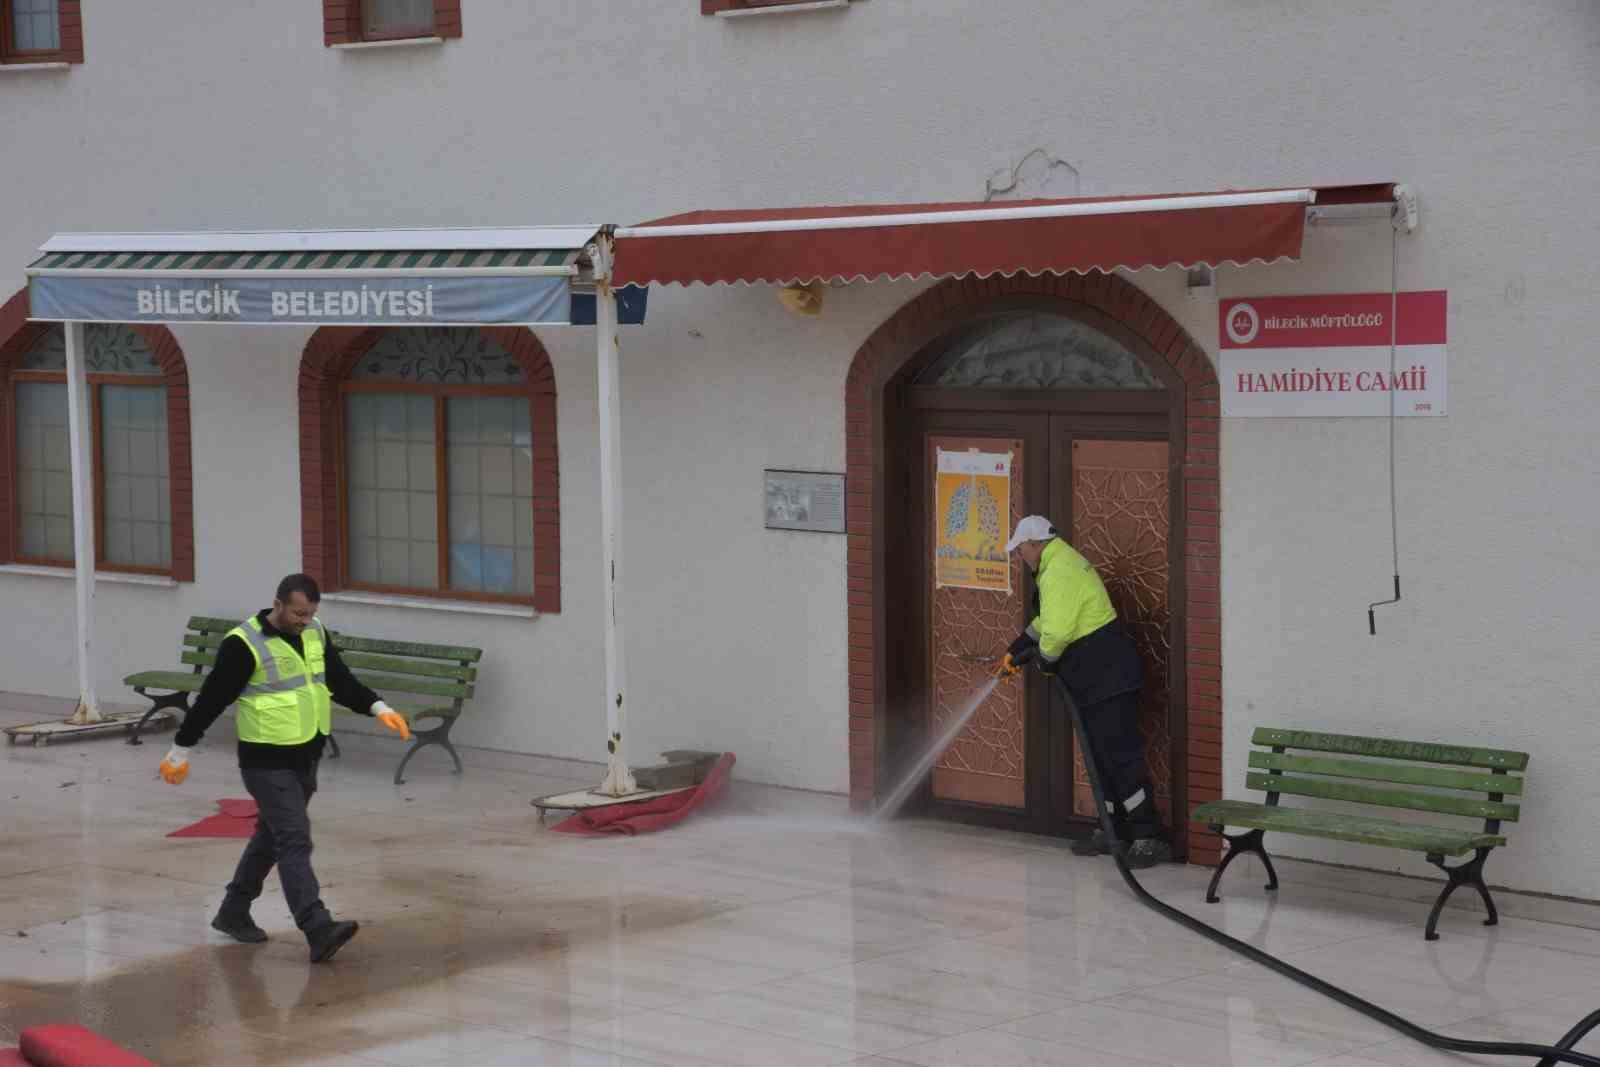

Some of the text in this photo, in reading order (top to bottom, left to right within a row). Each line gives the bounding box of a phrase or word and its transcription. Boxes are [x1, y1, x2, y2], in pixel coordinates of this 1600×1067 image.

[136, 284, 434, 316] BİLECİK BELEDİYESİ
[1264, 315, 1309, 329] BİLECİK
[1237, 365, 1427, 393] HAMİDİYE CAMİİ
